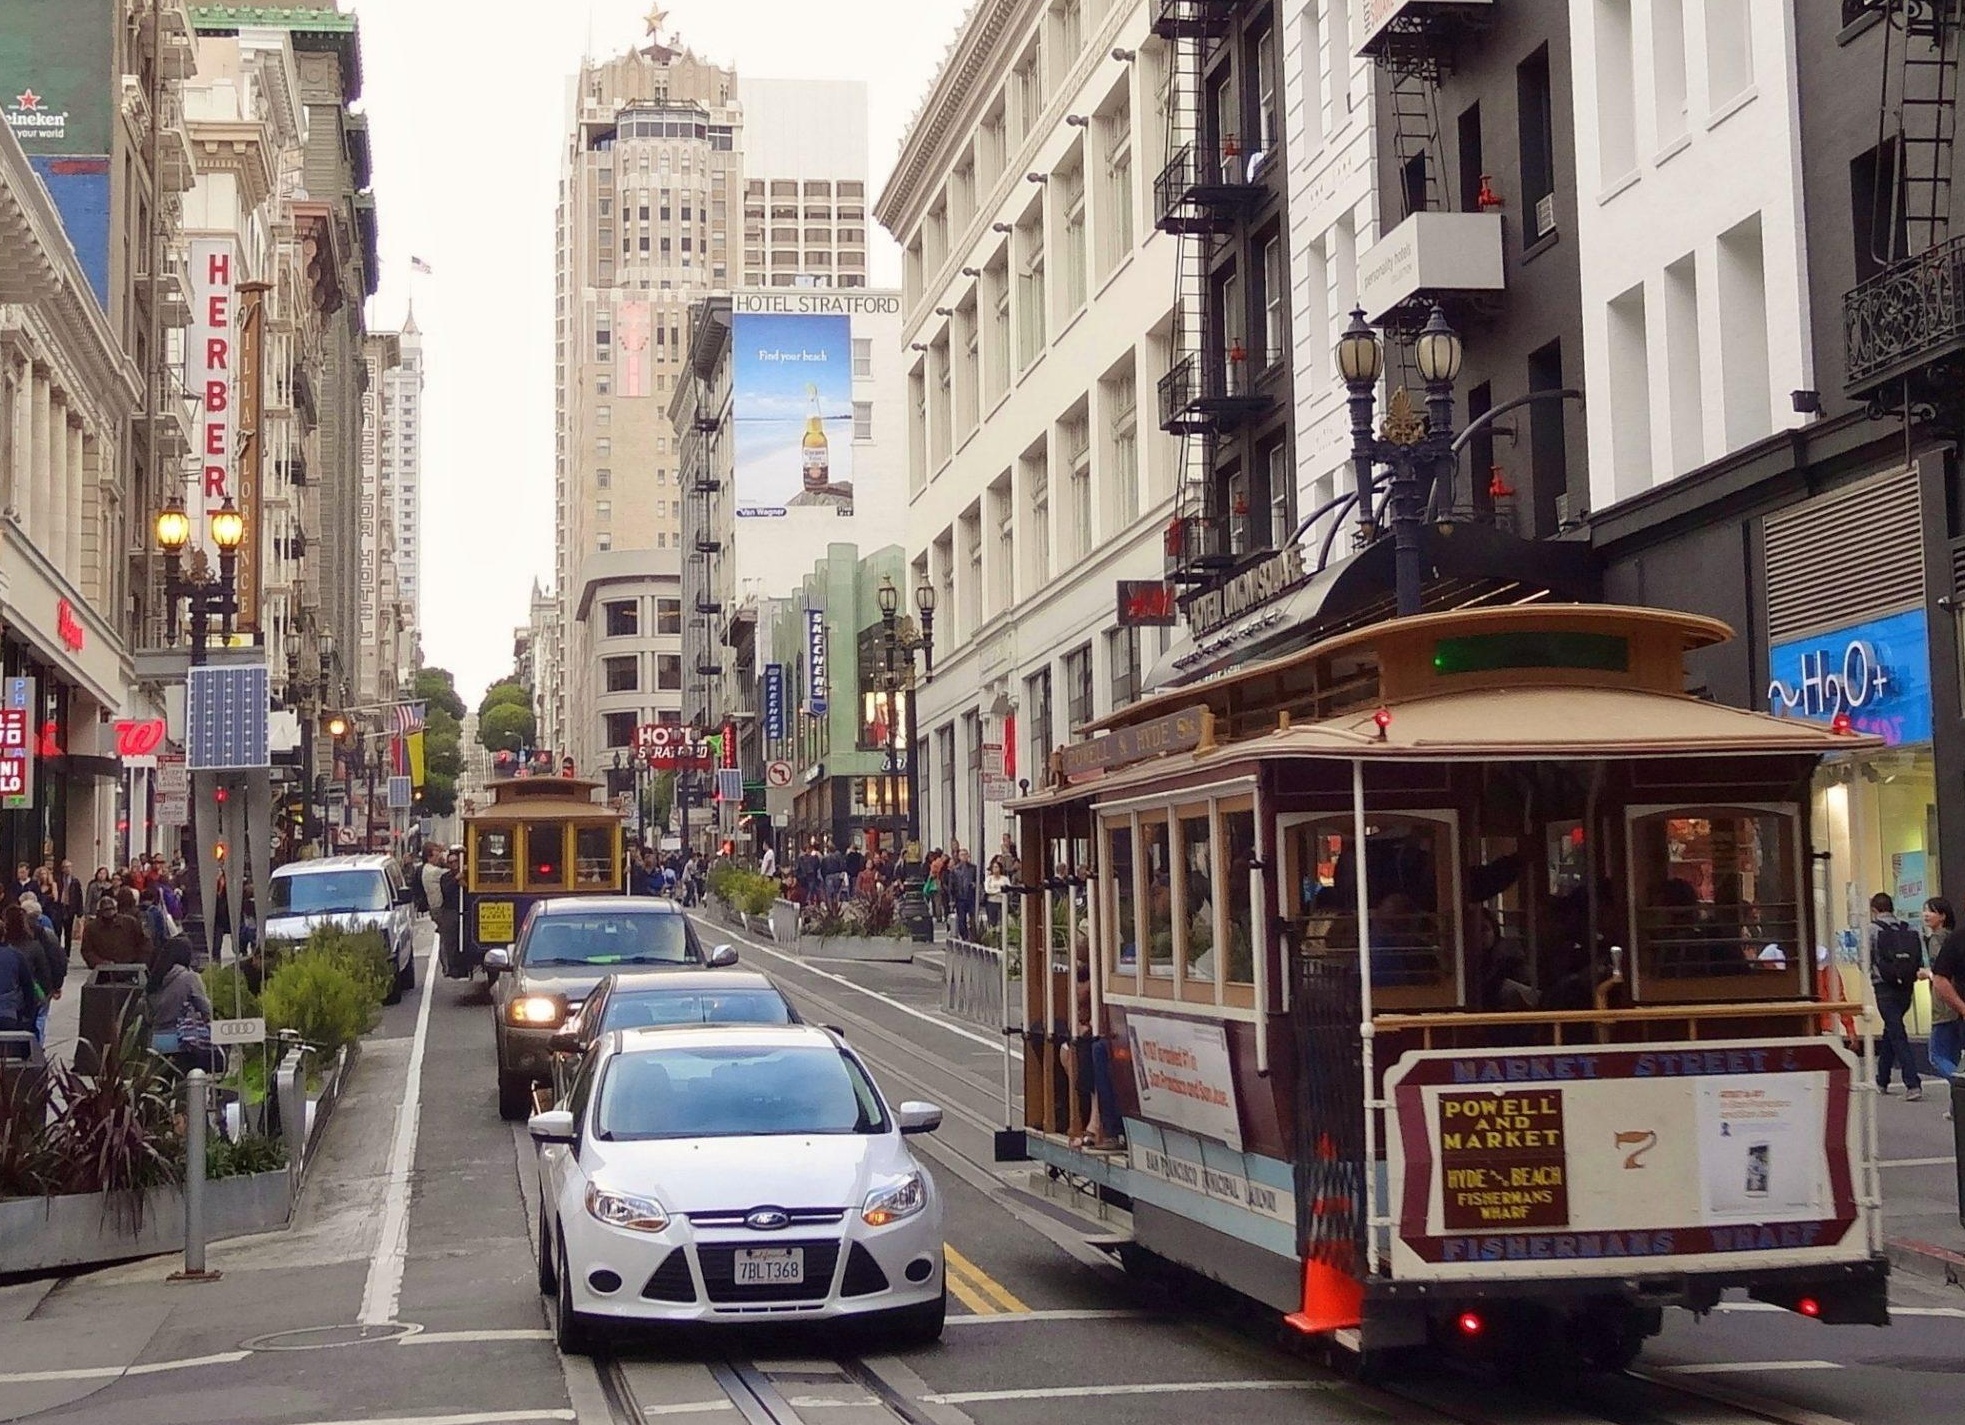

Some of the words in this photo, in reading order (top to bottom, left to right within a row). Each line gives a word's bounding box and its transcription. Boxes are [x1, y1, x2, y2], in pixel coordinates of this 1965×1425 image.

[4, 112, 65, 126] eineken
[17, 129, 37, 139] your
[39, 128, 65, 138] world
[737, 295, 793, 312] HOTEL
[798, 296, 900, 313] STRATFORD
[758, 350, 779, 361] Find
[780, 353, 801, 364] your
[803, 350, 828, 361] beach
[204, 254, 229, 516] HERBER
[756, 508, 785, 517] Wagner
[811, 612, 825, 697] SKECHERS
[1136, 722, 1171, 751] HYDE
[1452, 1058, 1600, 1083] MARKET
[1634, 1049, 1768, 1077] STREET
[1445, 1098, 1557, 1118] POWELL
[1474, 1116, 1531, 1131] AND
[1443, 1129, 1560, 1150] MARKET
[1613, 1129, 1658, 1170] 7
[1446, 1168, 1489, 1189] HYDE
[1510, 1166, 1562, 1187] BEACH
[1457, 1190, 1553, 1207] FISHERMANS
[1480, 1205, 1531, 1219] WHARF
[1442, 1231, 1675, 1261] FISHERMANS
[1710, 1222, 1822, 1250] WHARF
[739, 1261, 799, 1279] 7BLT368
